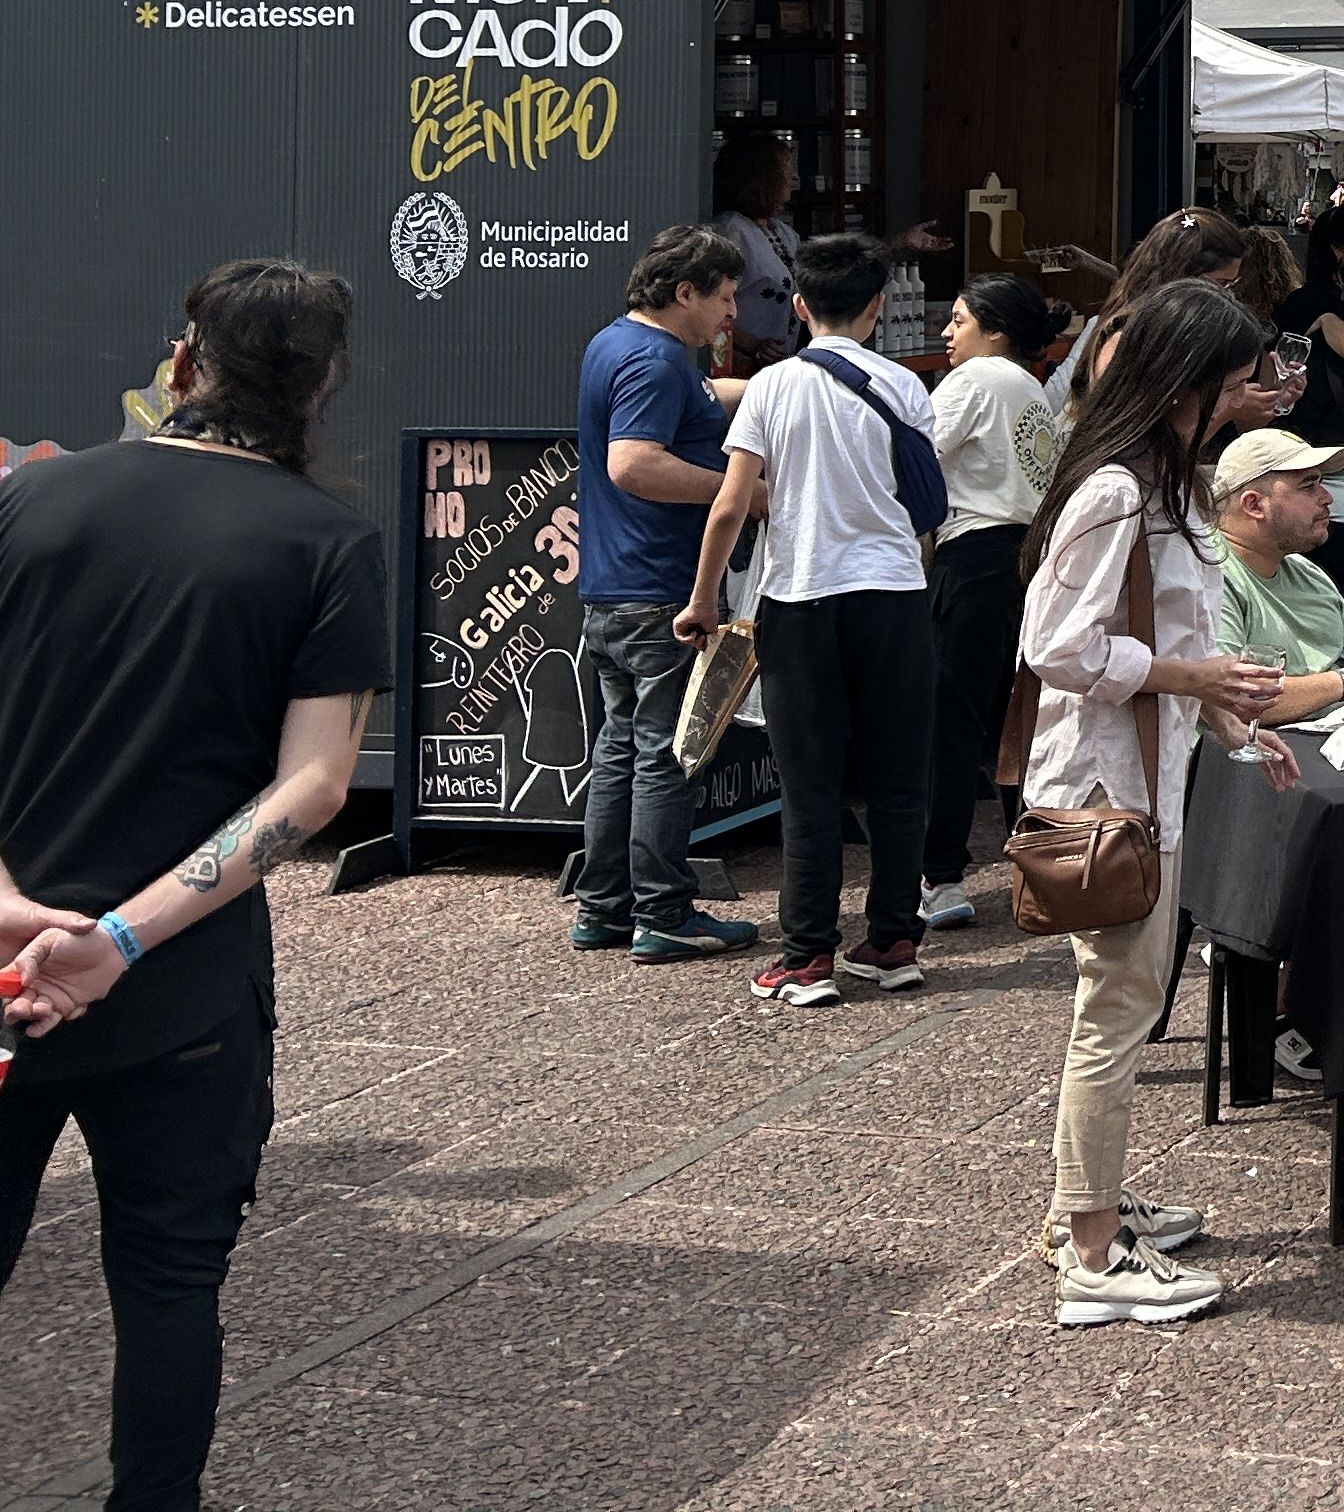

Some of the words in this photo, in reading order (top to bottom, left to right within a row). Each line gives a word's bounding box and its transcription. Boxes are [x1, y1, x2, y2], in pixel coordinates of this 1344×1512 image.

[165, 1, 355, 28] Delicatessen
[410, 56, 483, 124] DEL
[411, 76, 618, 182] CENTRO
[480, 248, 505, 268] de
[511, 247, 589, 268] Rosario
[481, 220, 629, 246] Municipalidad
[426, 439, 492, 490] PRO
[505, 438, 579, 520] BANCO
[502, 512, 520, 534] DE
[430, 514, 504, 600] SOCIOS
[460, 564, 545, 650] Galicia
[538, 593, 556, 615] de
[446, 624, 545, 735] REINTEGRO
[711, 761, 741, 808] ALGO
